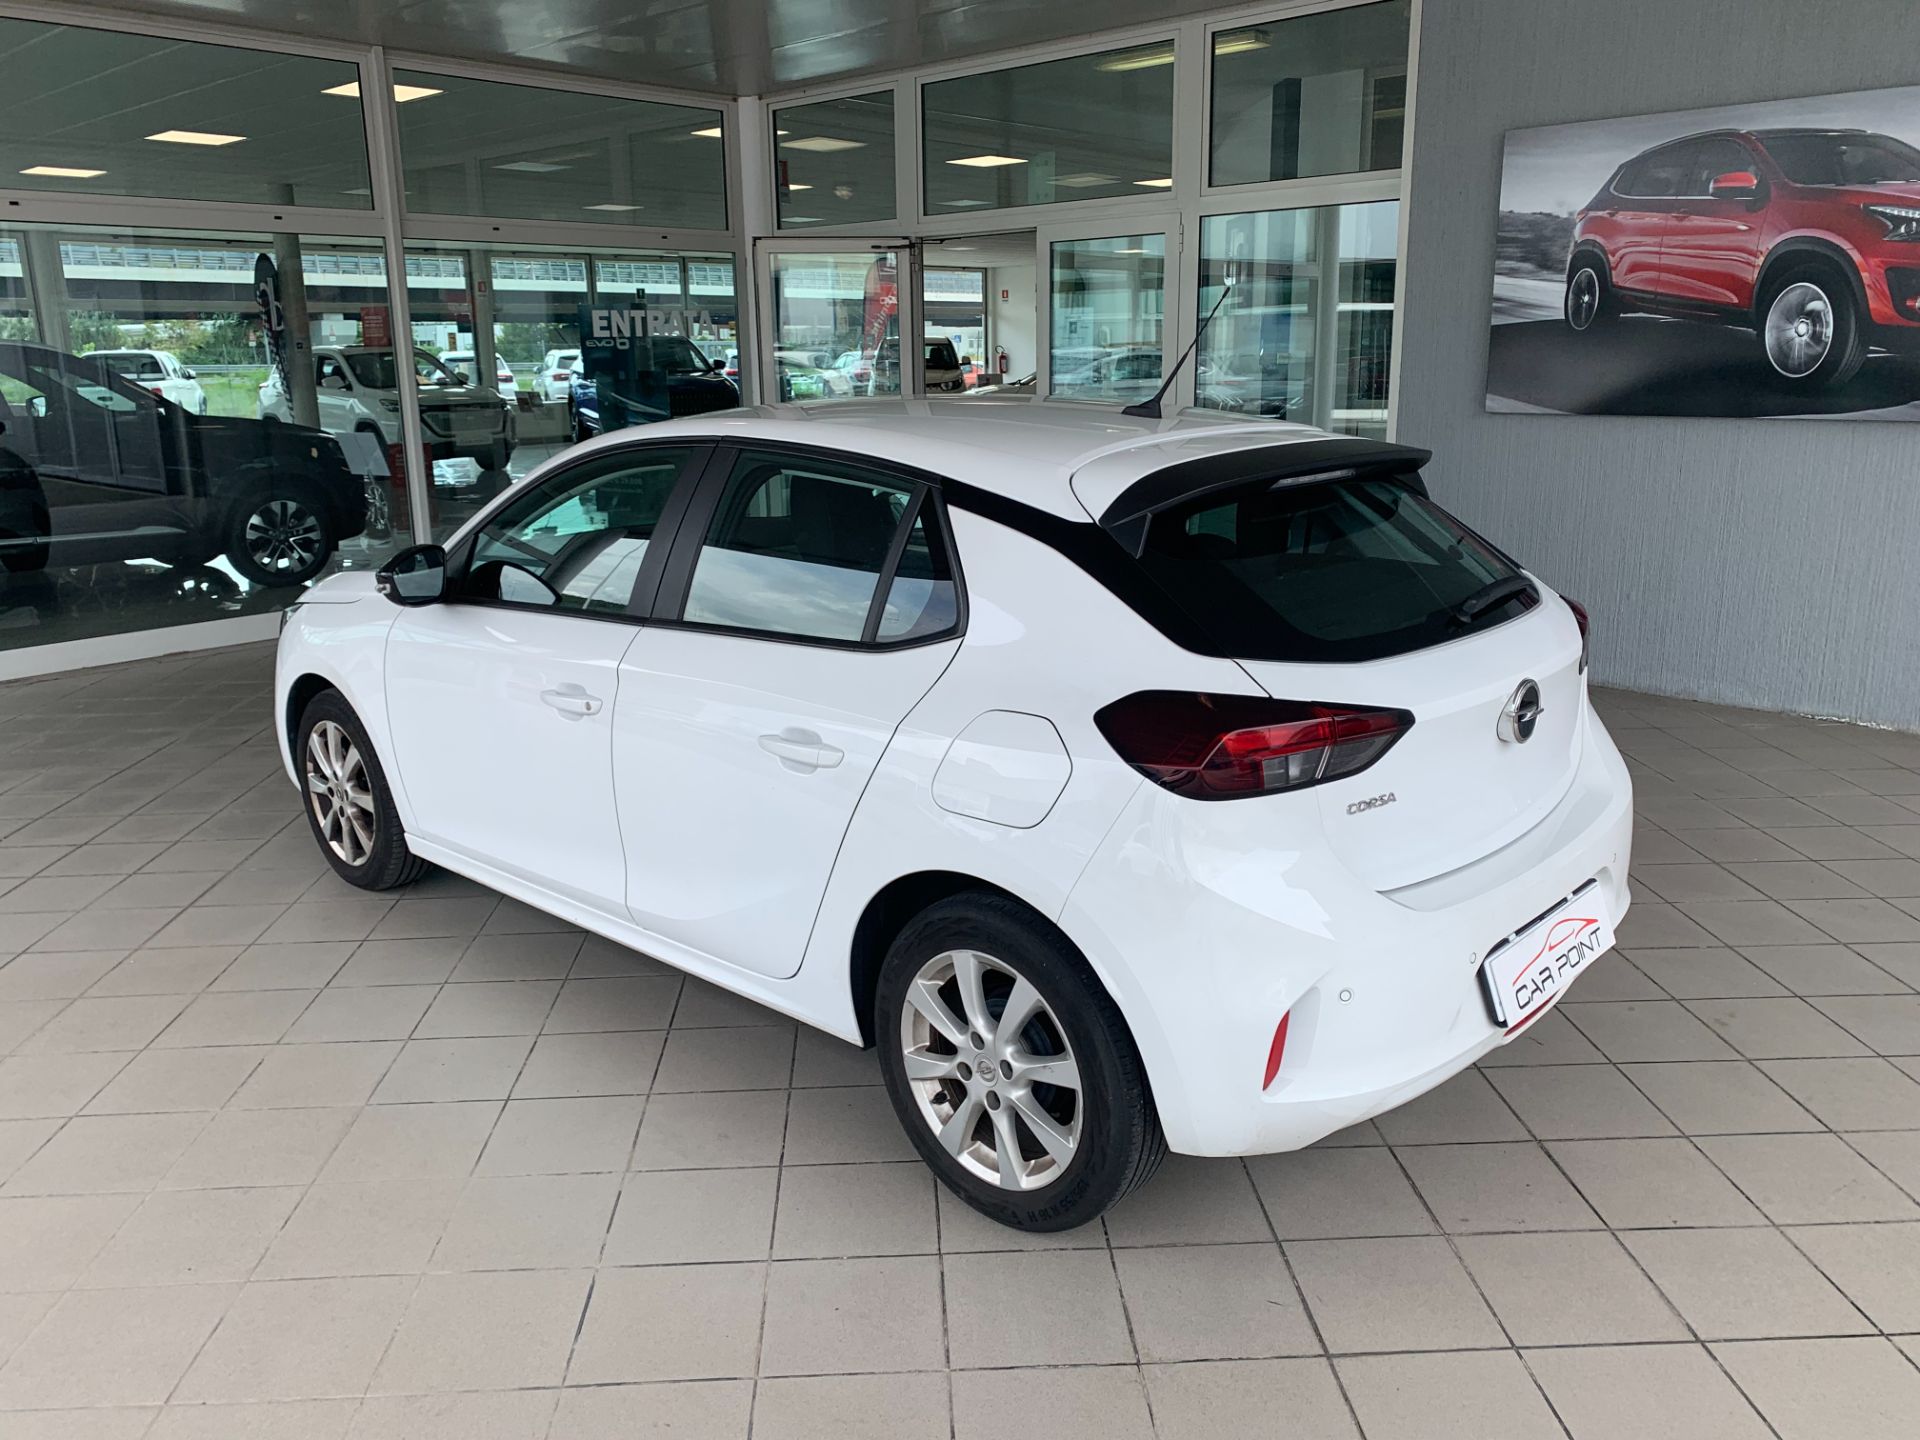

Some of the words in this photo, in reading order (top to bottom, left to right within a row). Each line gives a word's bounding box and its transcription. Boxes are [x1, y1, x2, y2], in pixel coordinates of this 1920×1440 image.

[591, 309, 716, 338] ENTRATA
[1346, 792, 1397, 815] CORSA
[1515, 966, 1555, 1010] CAR
[1555, 926, 1601, 978] POINT
